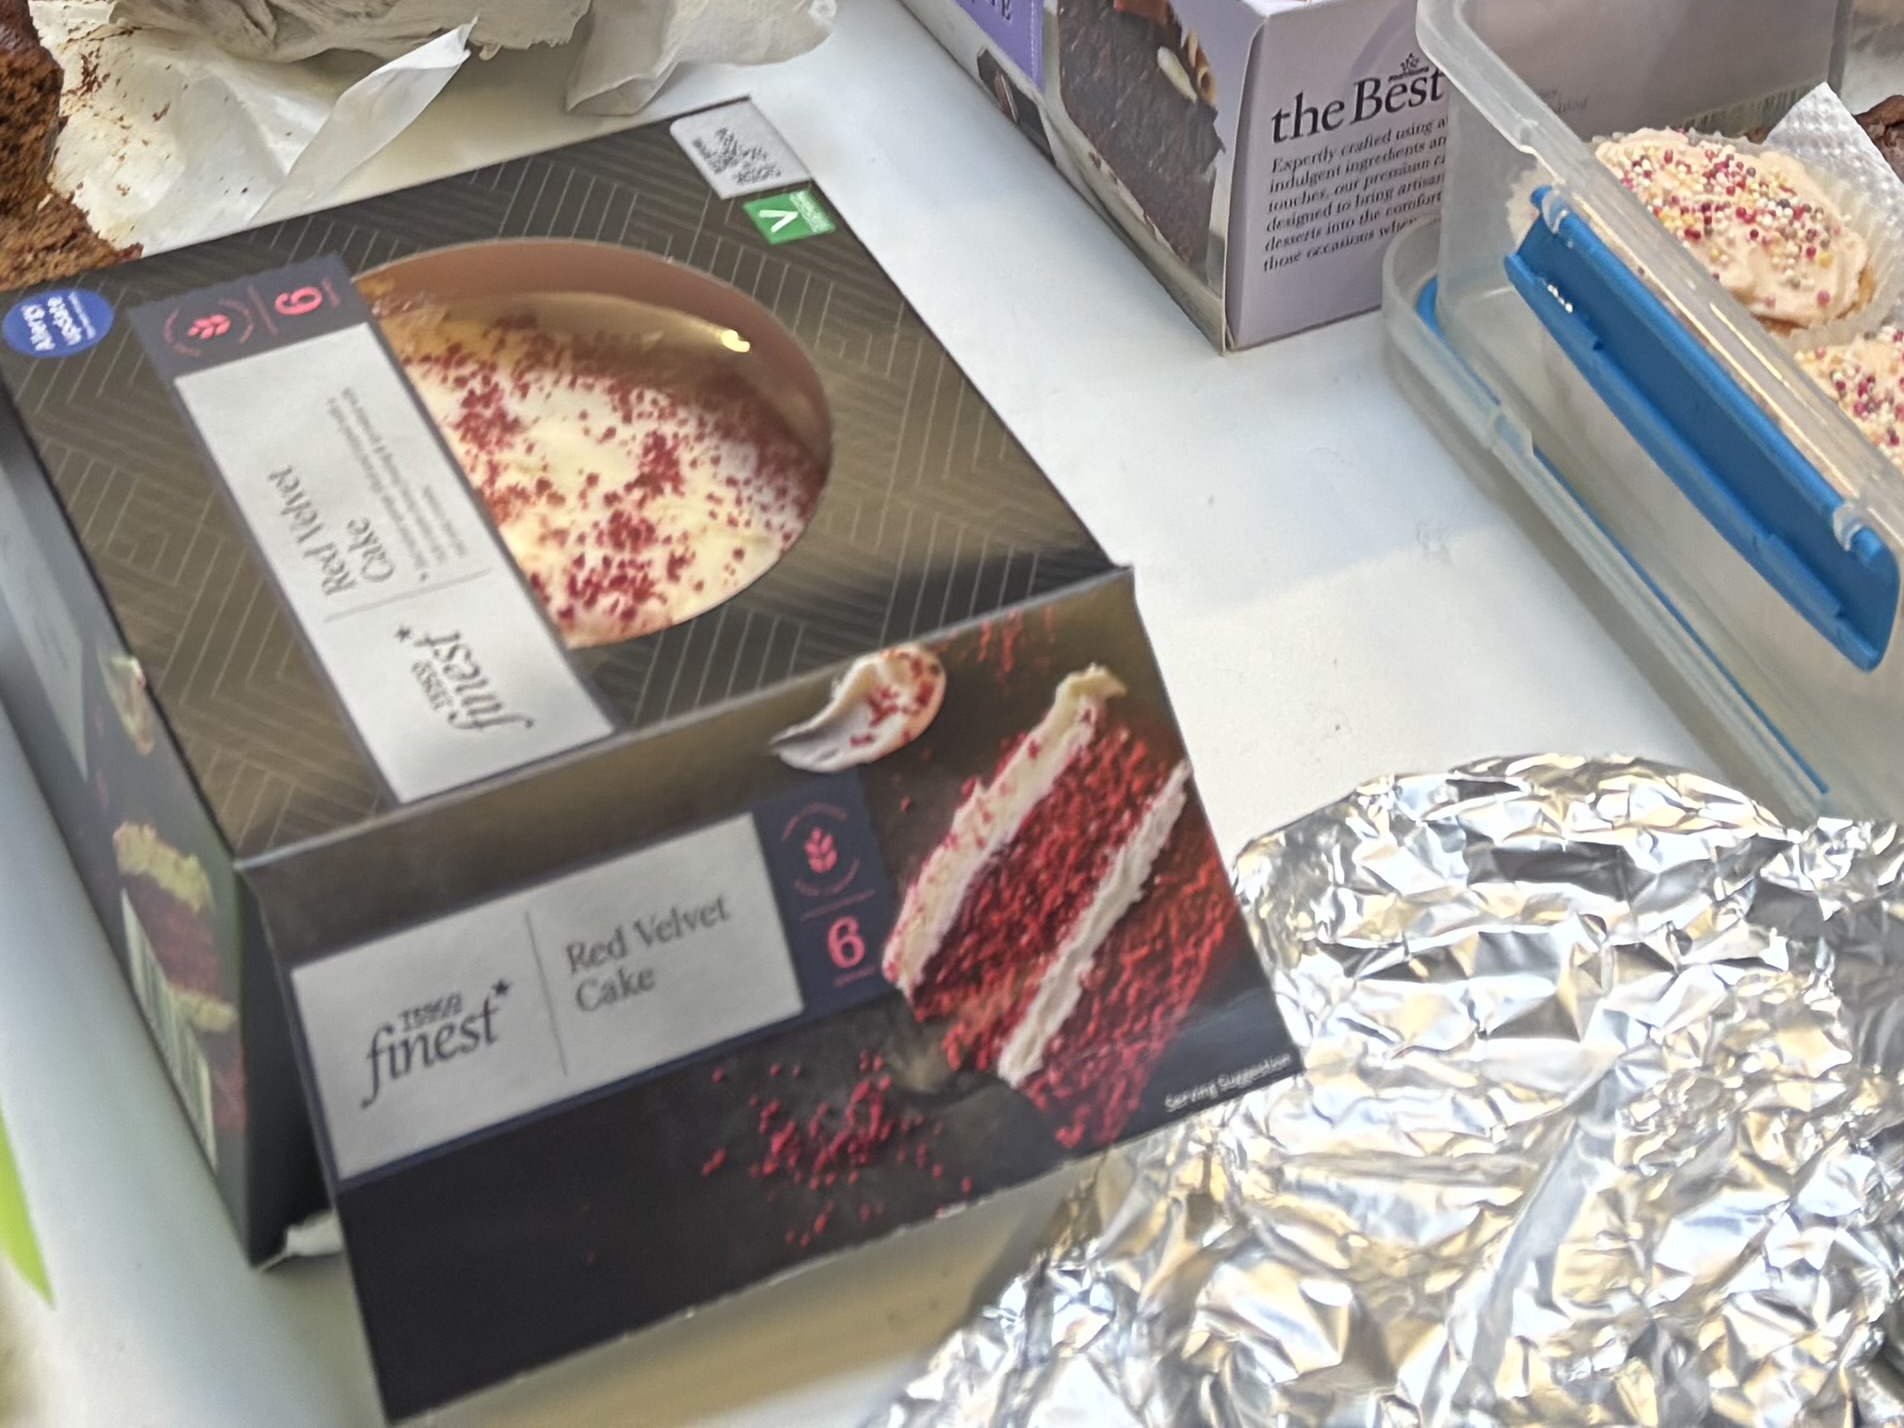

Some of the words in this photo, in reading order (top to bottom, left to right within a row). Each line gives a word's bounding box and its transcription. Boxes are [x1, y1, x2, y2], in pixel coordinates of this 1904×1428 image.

[1269, 93, 1347, 144] the
[1351, 68, 1446, 126] Best
[1266, 161, 1343, 195] indulgent
[1342, 139, 1427, 175] ingredients
[1269, 144, 1336, 178] Expertly
[1338, 128, 1394, 157] crafted
[1394, 120, 1434, 142] using
[1332, 180, 1360, 196] our
[1360, 159, 1431, 190] premium
[1262, 223, 1323, 252] desserts
[1324, 215, 1356, 234] into
[1357, 207, 1381, 224] the
[1383, 191, 1444, 217] comfort
[1263, 203, 1333, 236] designed
[1335, 199, 1352, 213] to
[1352, 186, 1394, 208] bring
[1261, 250, 1303, 272] those
[1304, 228, 1376, 258] occasions
[18, 300, 57, 355] Allergy
[44, 291, 85, 348] update
[274, 281, 327, 317] 6
[266, 465, 327, 549] Velvet
[301, 538, 358, 601] Red
[339, 516, 397, 588] Cake
[409, 630, 534, 736] finest
[564, 929, 631, 974] Red
[633, 895, 732, 948] Velvet
[821, 913, 870, 972] 6
[396, 991, 466, 1032] TESCO
[573, 961, 658, 1014] Cake
[361, 996, 498, 1106] finest
[1162, 1081, 1219, 1112] Serving
[1214, 1052, 1295, 1093] Suggestion
